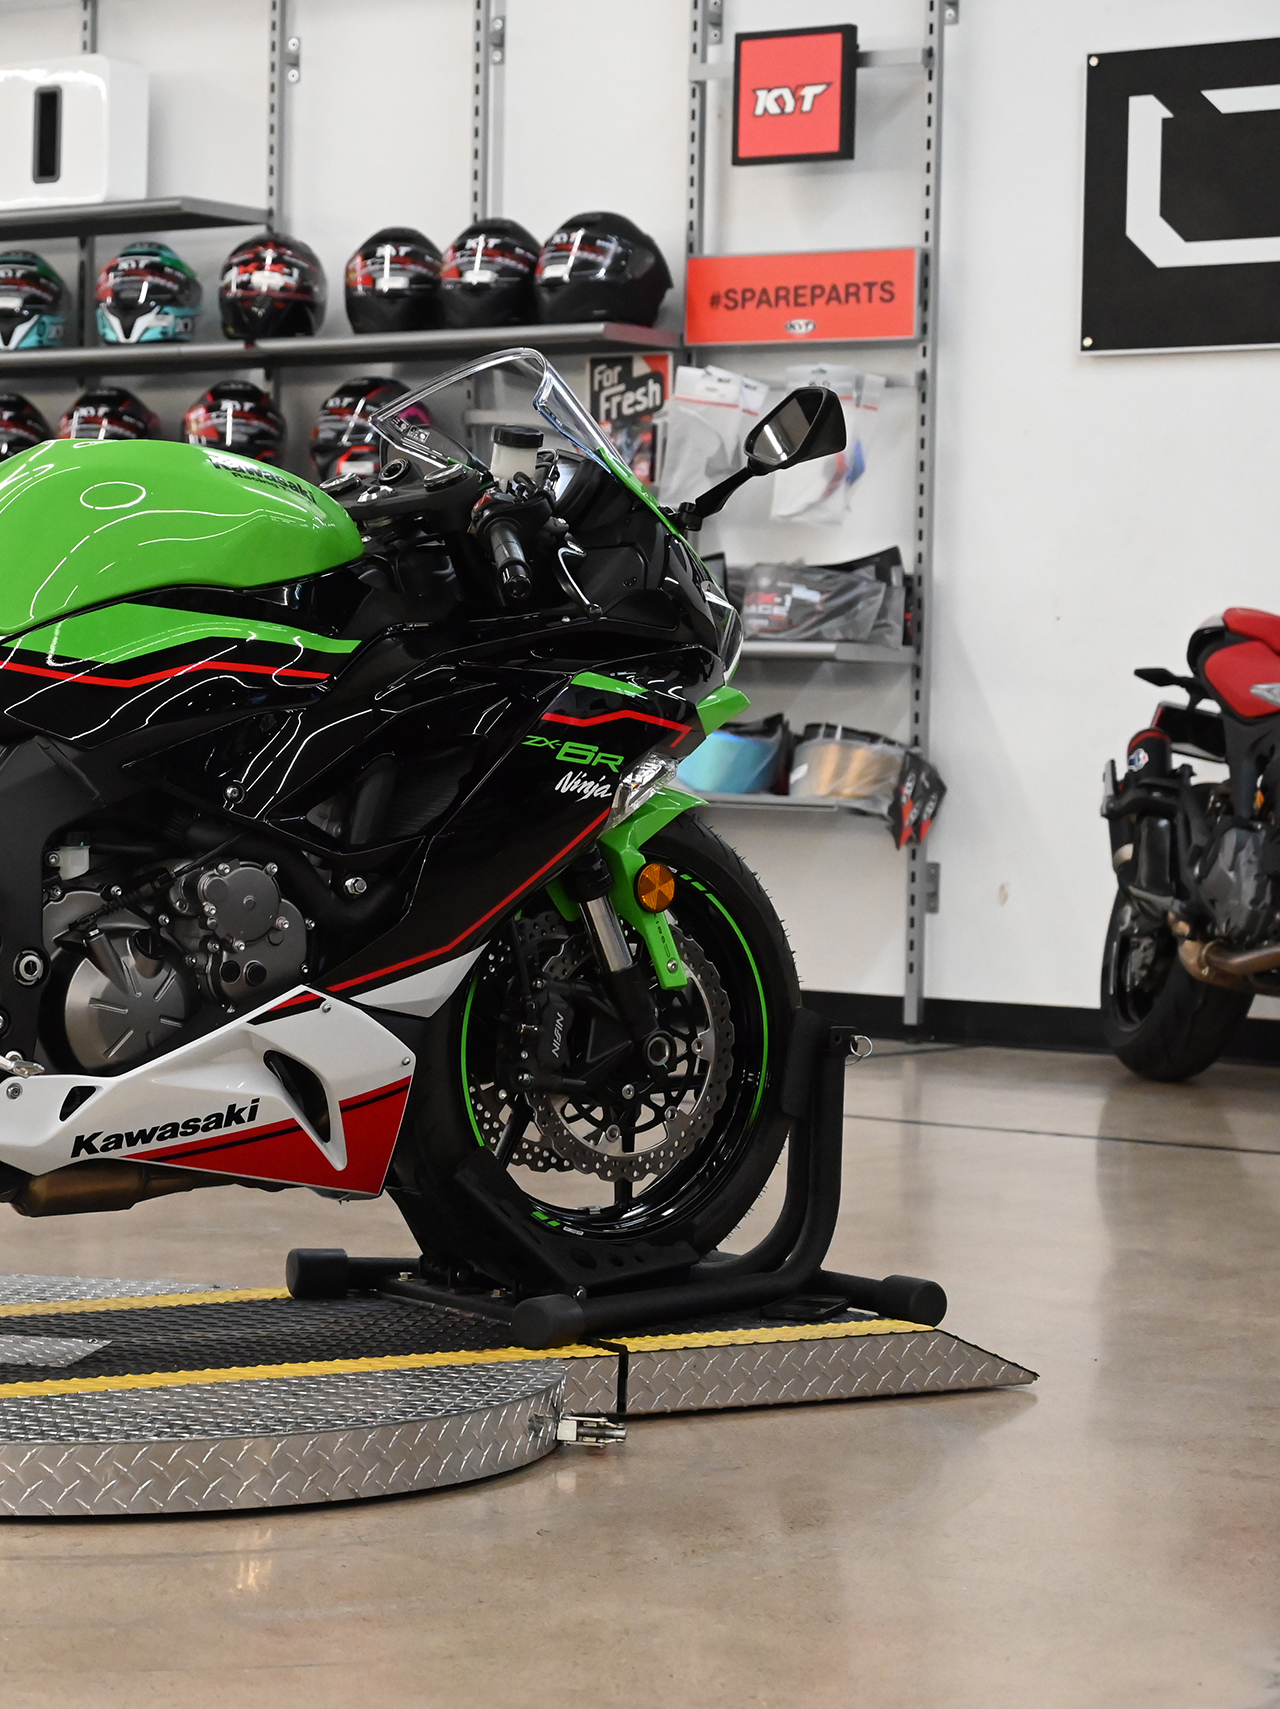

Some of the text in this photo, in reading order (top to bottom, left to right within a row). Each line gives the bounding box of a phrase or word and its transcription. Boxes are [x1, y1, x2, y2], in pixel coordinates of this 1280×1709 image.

[753, 82, 833, 117] KYT
[710, 280, 896, 311] #SPAREPARTS
[593, 364, 622, 391] For
[599, 378, 662, 421] Fresh
[522, 735, 624, 773] ZX-6R
[554, 770, 613, 803] Ninja
[70, 1097, 261, 1159] Kawasaki
